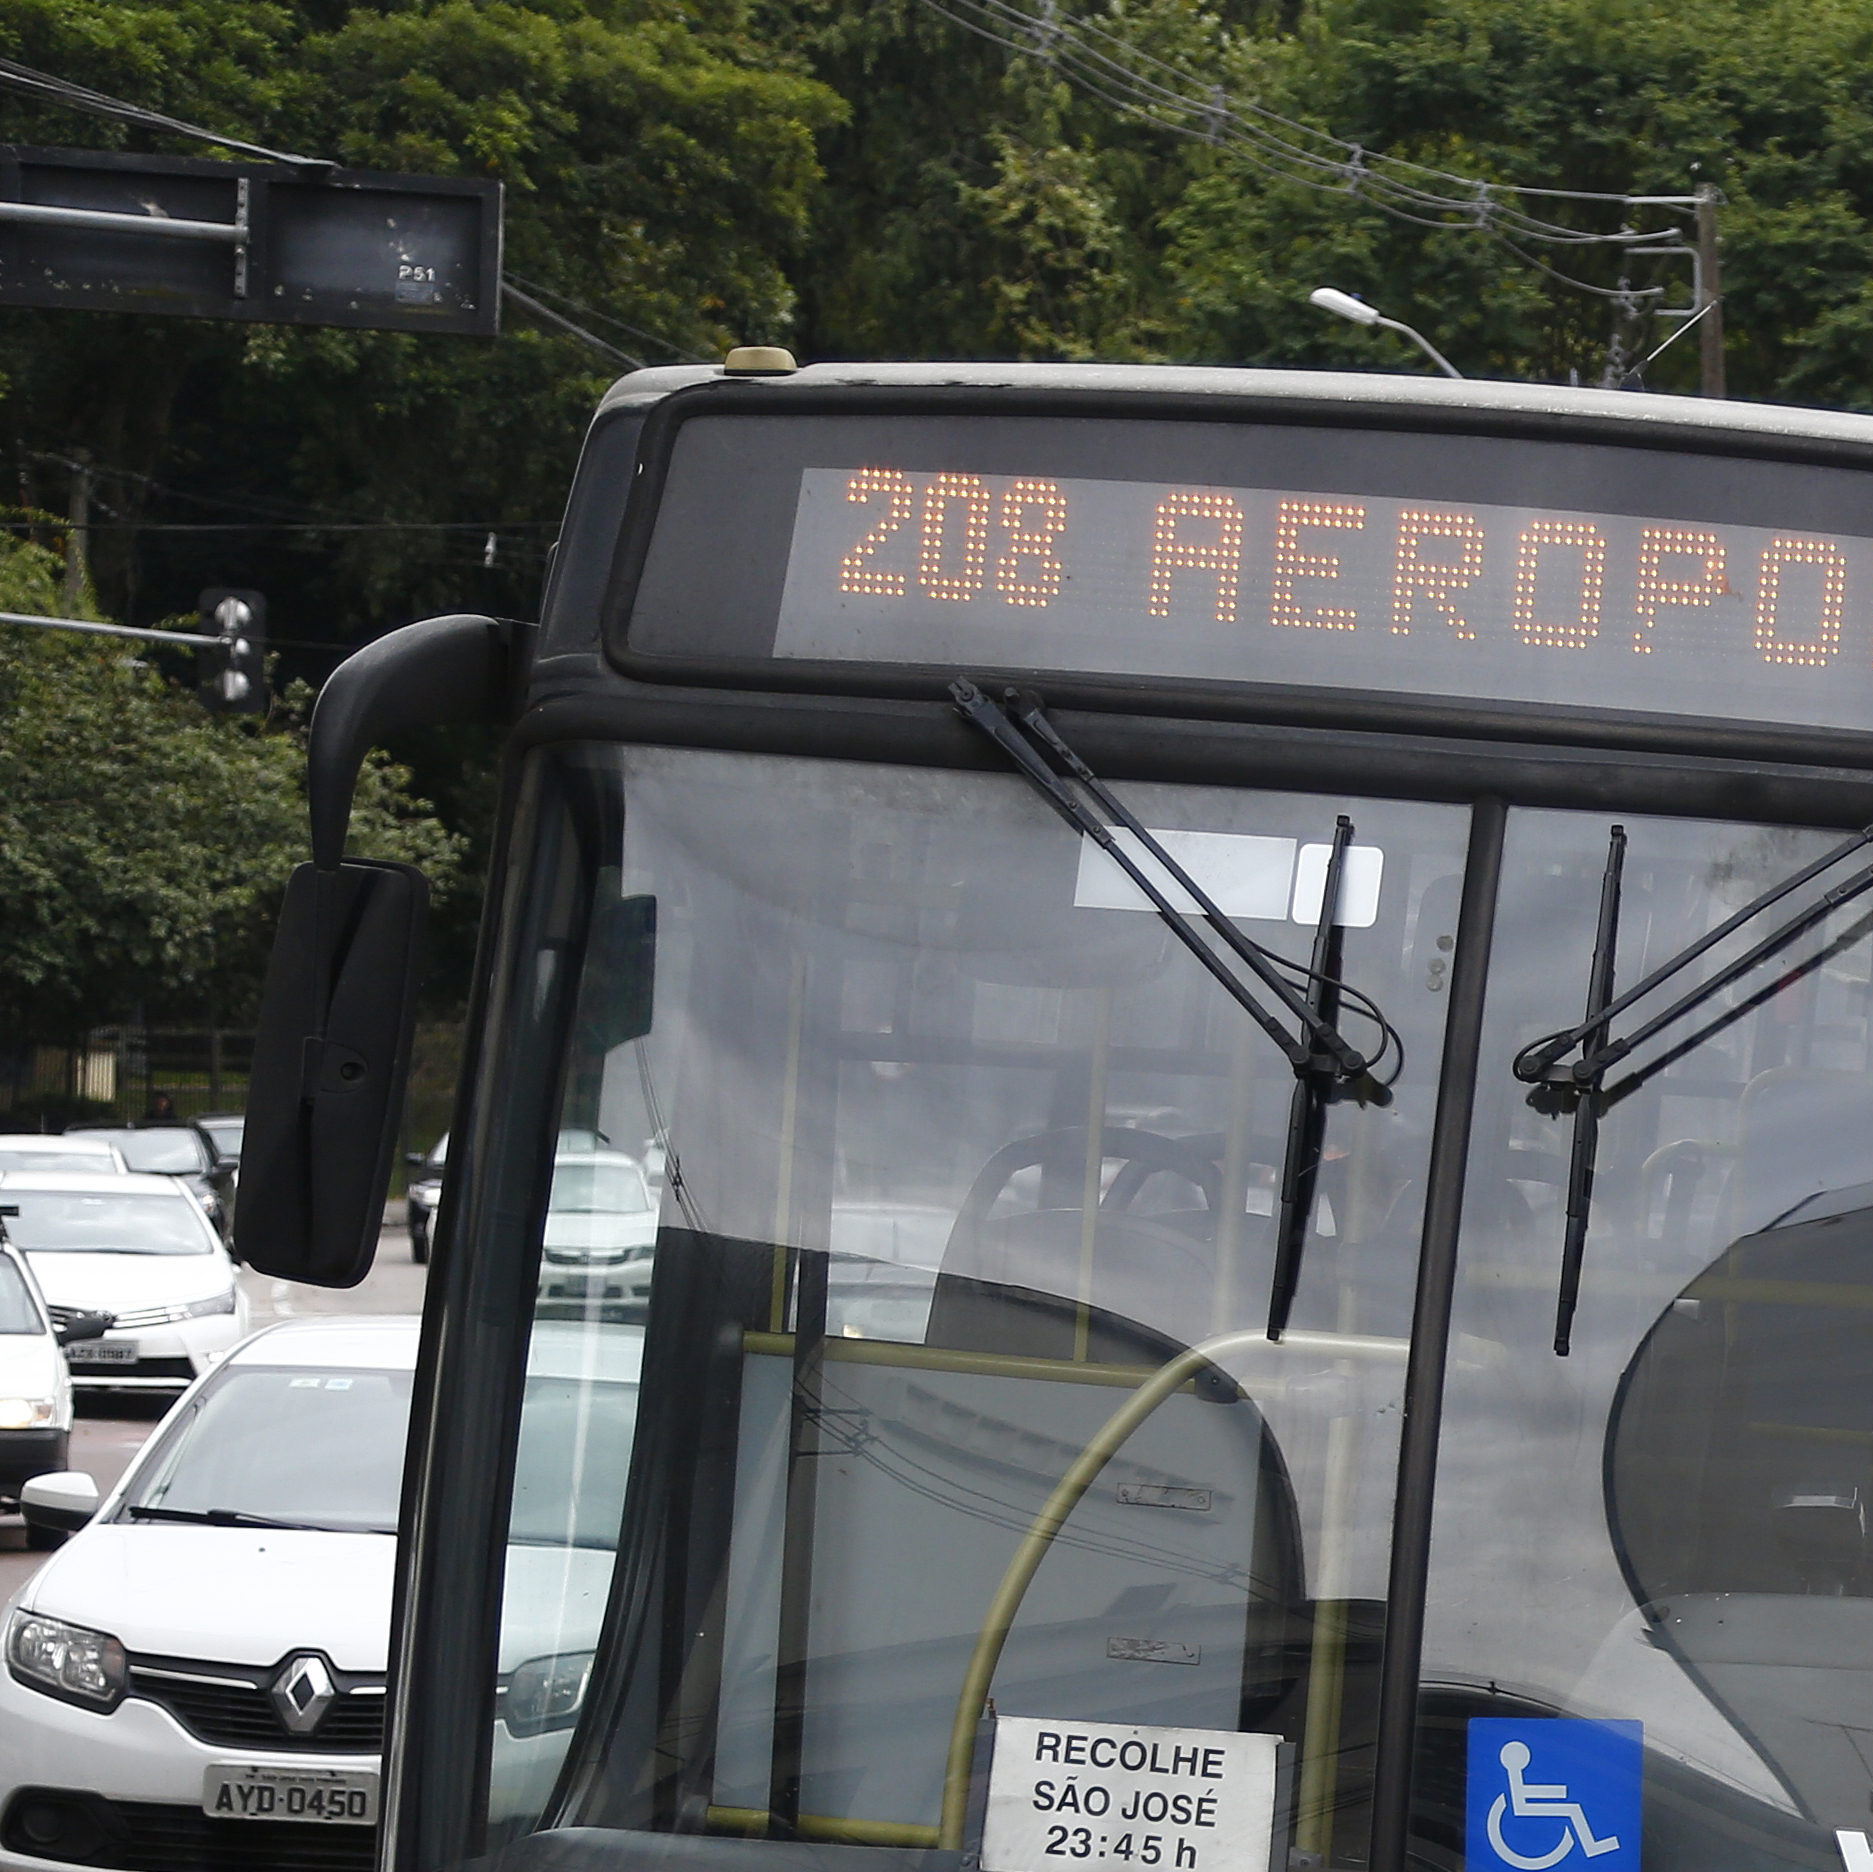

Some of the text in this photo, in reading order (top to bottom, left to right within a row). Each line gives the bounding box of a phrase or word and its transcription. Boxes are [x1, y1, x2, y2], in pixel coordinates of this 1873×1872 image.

[841, 468, 1067, 608] 208
[1035, 1731, 1225, 1779] RECOLHE
[1032, 1775, 1218, 1827] SÃO JOSÉ
[1045, 1825, 1198, 1869] 23:45 h
